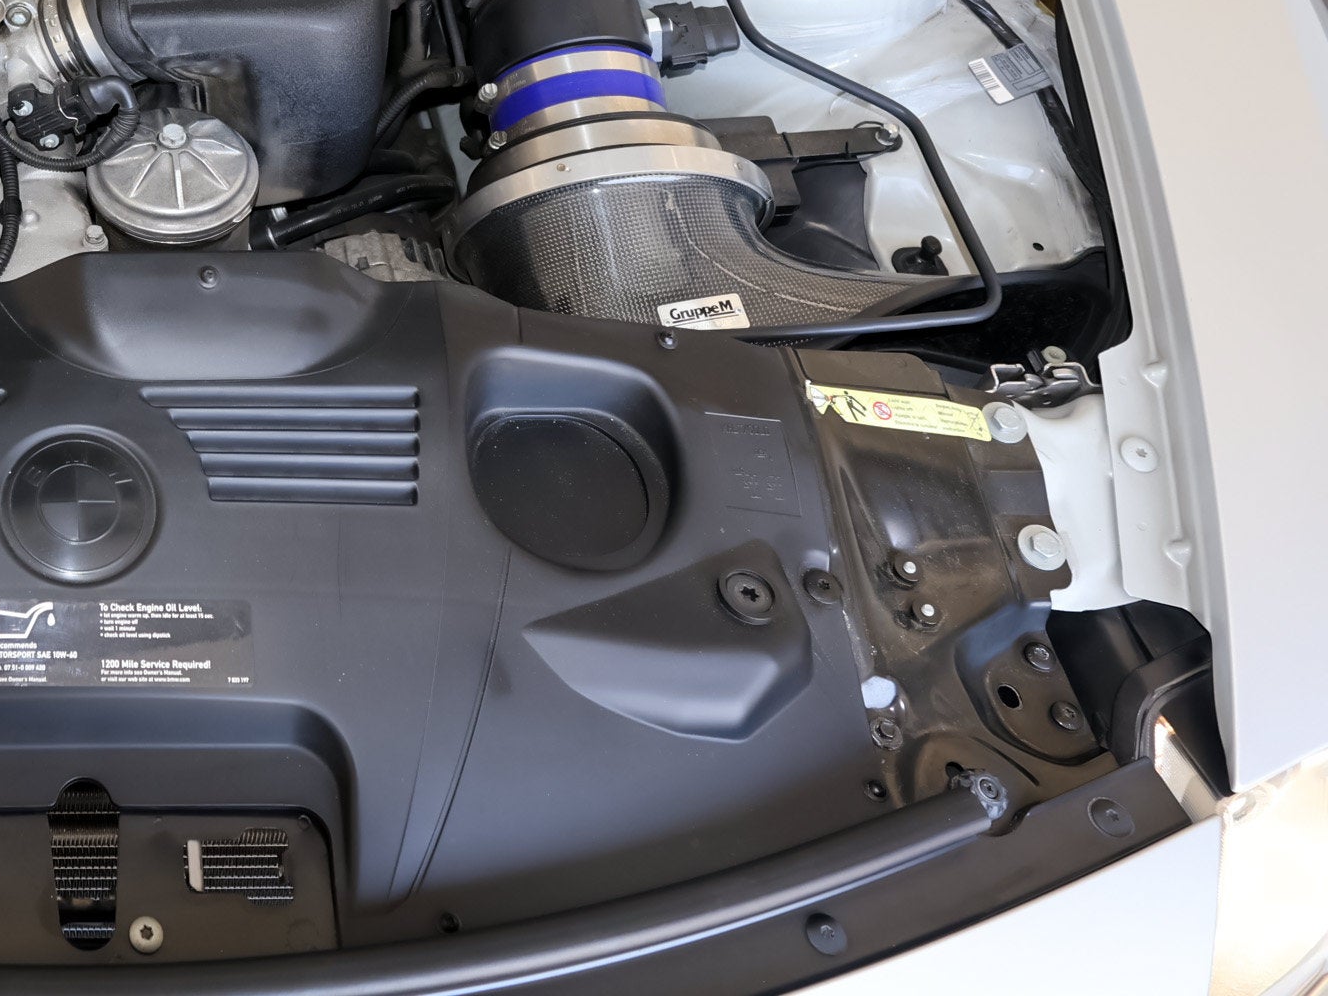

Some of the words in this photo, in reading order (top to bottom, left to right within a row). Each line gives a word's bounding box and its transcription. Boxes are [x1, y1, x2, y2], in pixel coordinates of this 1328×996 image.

[99, 603, 108, 612] To
[110, 603, 134, 612] Check
[136, 603, 163, 613] Engine
[166, 603, 176, 612] Oil
[179, 603, 202, 612] Level:
[37, 651, 51, 659] SAE
[53, 651, 78, 659] 10W-60
[101, 660, 119, 668] 1200
[122, 660, 138, 668] Mile
[141, 660, 170, 668] Service
[172, 660, 211, 670] Required!
